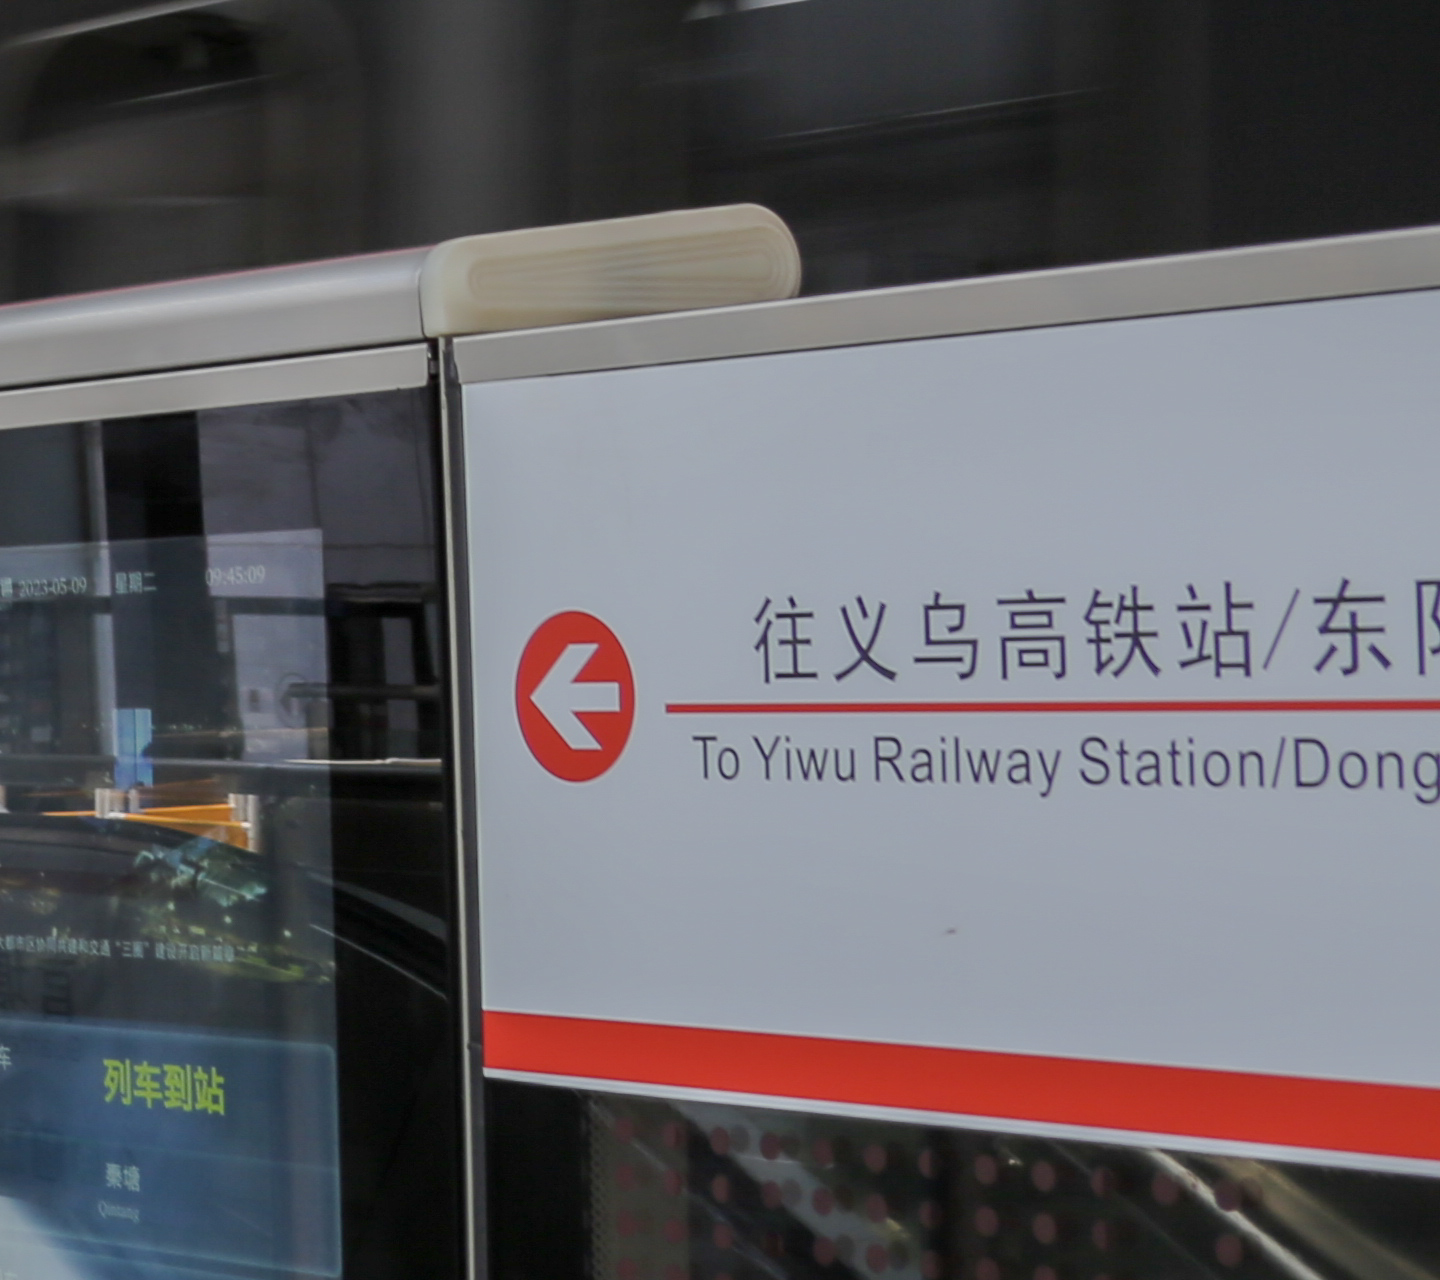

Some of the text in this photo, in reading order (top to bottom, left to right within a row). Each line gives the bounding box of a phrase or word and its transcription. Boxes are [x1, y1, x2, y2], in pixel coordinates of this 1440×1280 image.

[18, 576, 87, 597] 2023-05-09
[205, 565, 266, 587] 09:45:09
[692, 734, 741, 782] To
[752, 734, 857, 783] Yiwu
[874, 734, 1062, 798] Railway
[102, 1055, 226, 1117] 列车到站
